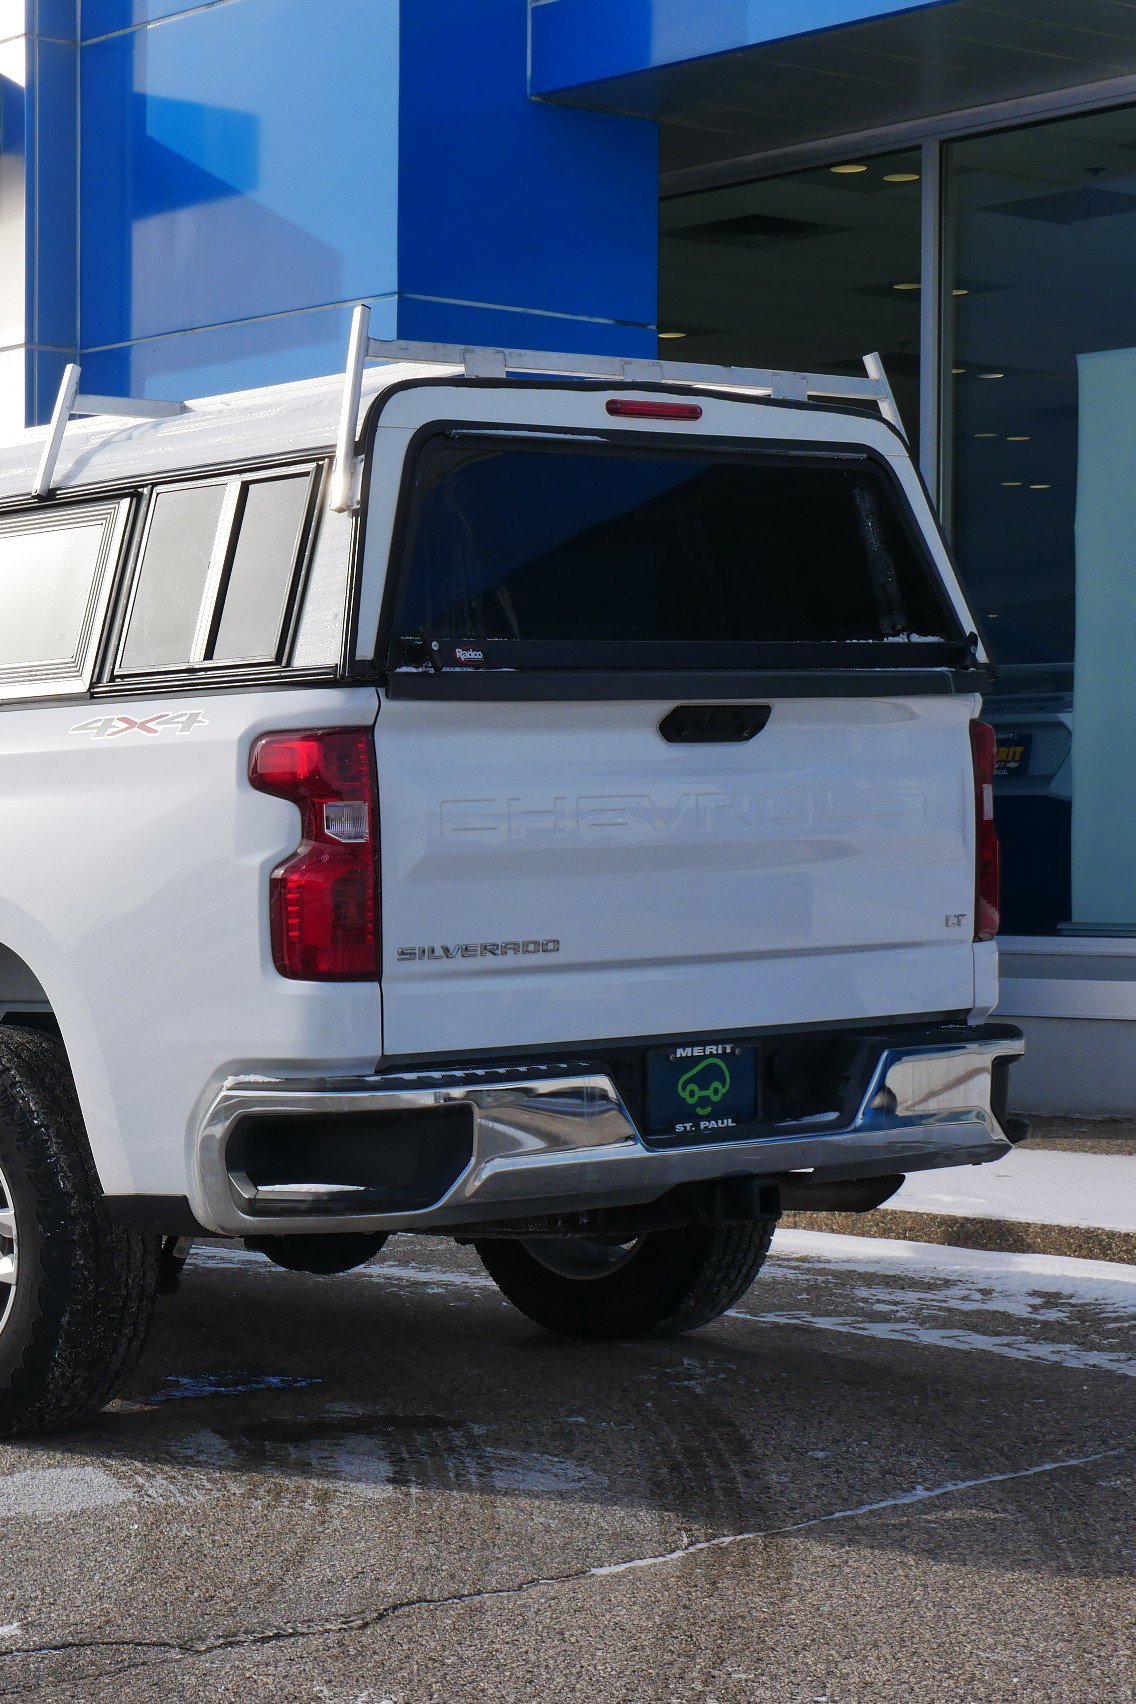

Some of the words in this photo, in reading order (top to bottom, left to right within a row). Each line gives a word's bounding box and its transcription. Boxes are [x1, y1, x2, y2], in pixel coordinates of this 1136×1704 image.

[455, 648, 483, 661] Radco
[997, 746, 1024, 761] RIT
[440, 788, 929, 841] CHEVROLET
[944, 913, 967, 928] LT
[396, 938, 561, 962] SILVERADO
[675, 1044, 734, 1058] MERIT
[675, 1123, 696, 1132] ST.
[699, 1118, 737, 1130] PAUL
